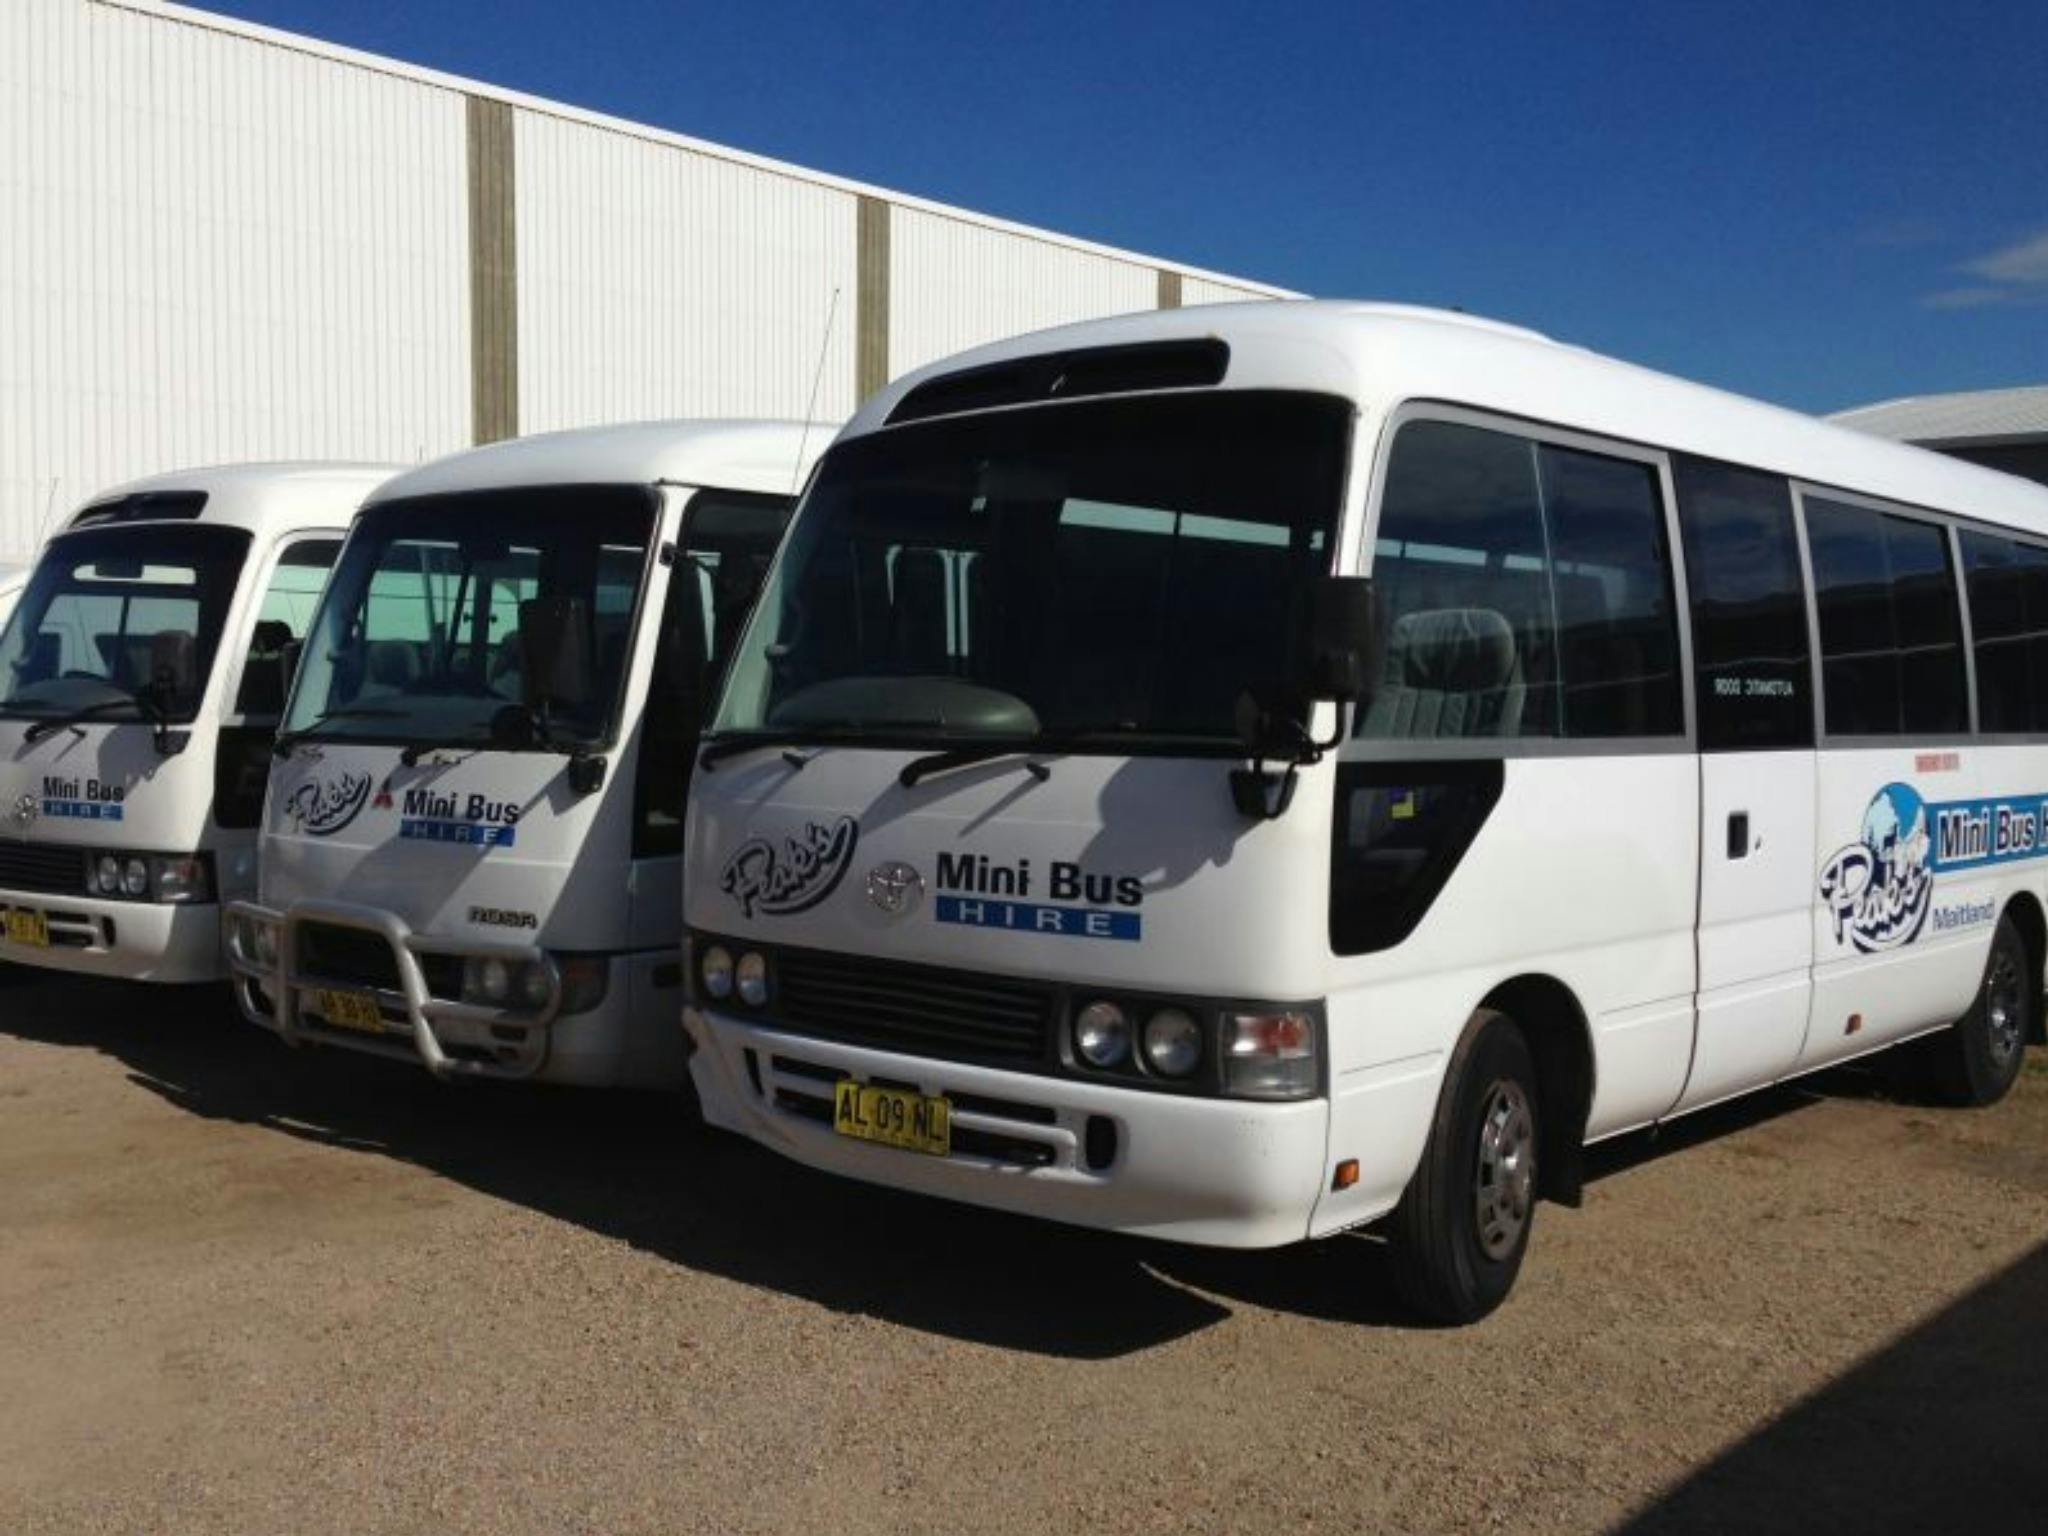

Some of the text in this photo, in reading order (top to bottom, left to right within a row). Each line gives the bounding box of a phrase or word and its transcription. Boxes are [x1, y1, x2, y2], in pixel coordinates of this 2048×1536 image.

[43, 776, 124, 802] Mini Bus
[403, 789, 520, 825] Mini Bus
[414, 823, 499, 844] HIRE
[1937, 806, 1991, 864] Mini
[1994, 804, 2036, 856] Bus
[936, 851, 1144, 907] Mini Bus
[959, 901, 1113, 936] HIRE
[1933, 897, 1995, 931] Maitland
[839, 1086, 945, 1141] AL 09 NL
